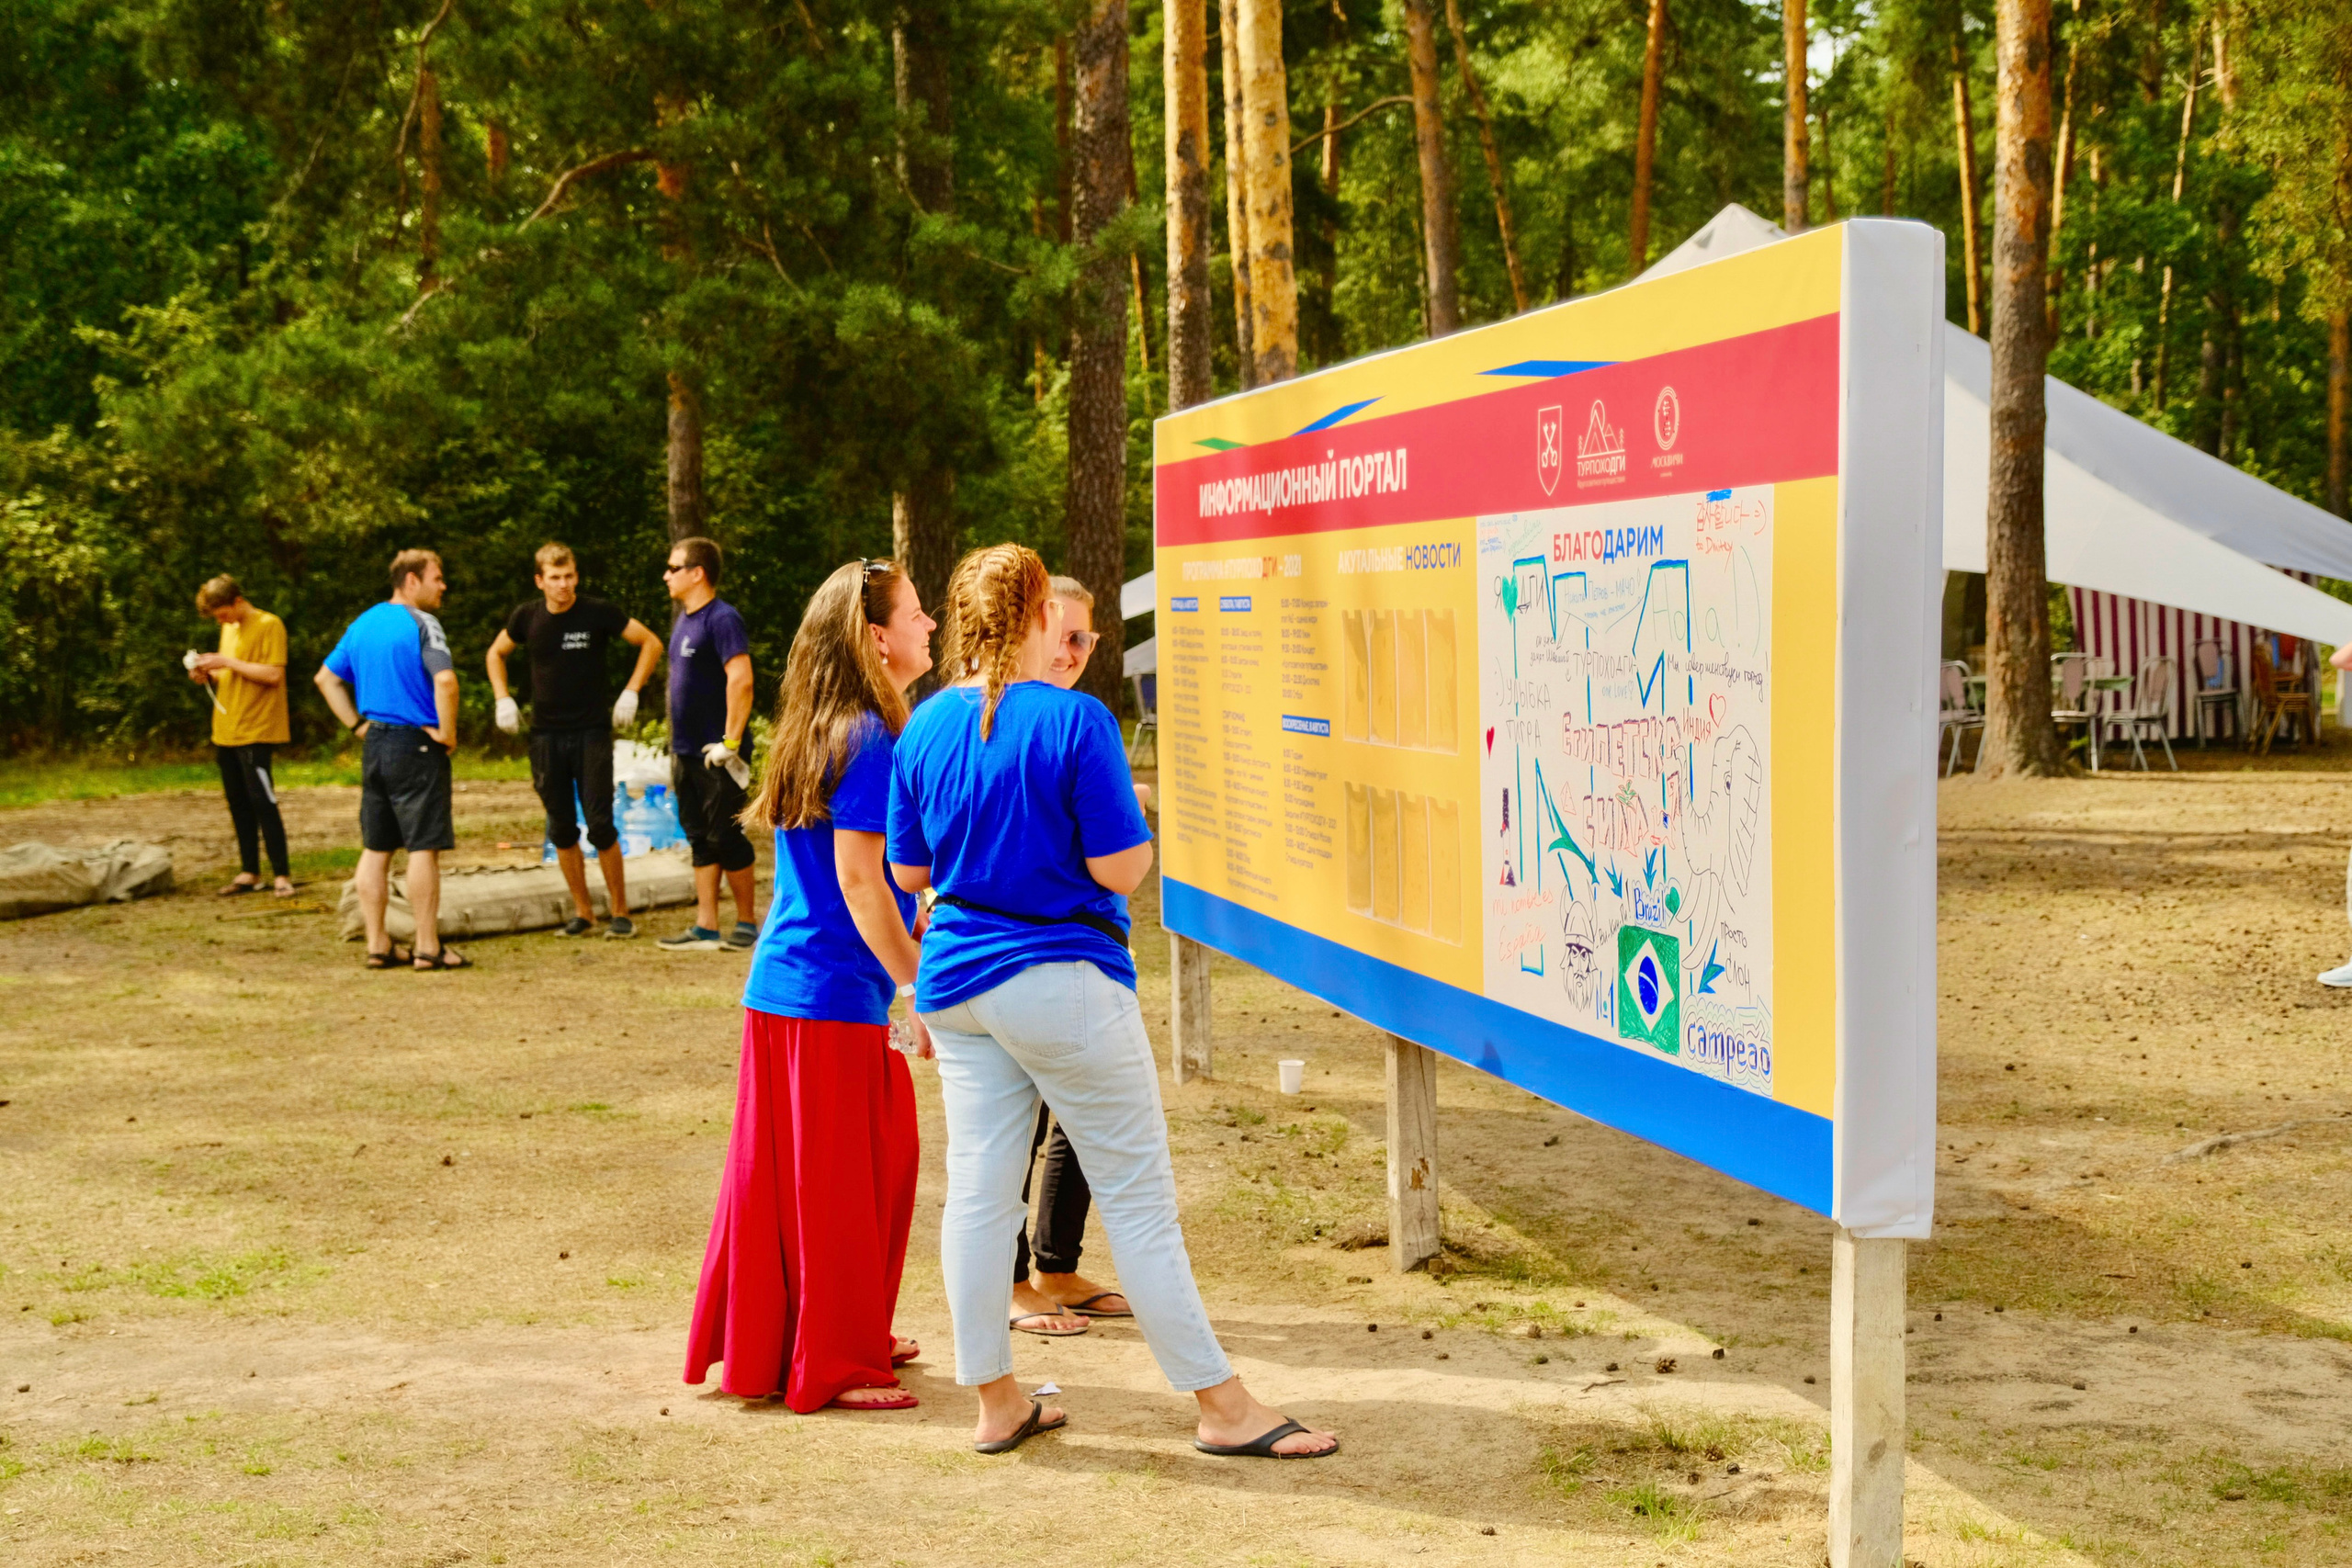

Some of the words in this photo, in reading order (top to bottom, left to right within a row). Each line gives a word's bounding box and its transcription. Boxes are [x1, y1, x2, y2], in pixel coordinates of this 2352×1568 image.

[1577, 455, 1626, 477] ТУРПОХОДГИ
[1199, 449, 1337, 518] ИНФОРМАЦИОННЫЙ
[1339, 447, 1408, 499] ПОРТАЛ
[1406, 542, 1462, 570] НОВОСТИ
[1553, 525, 1665, 564] БЛАГОДАРИМ
[1283, 553, 1302, 578] 2021
[1634, 886, 1667, 921] Brazil
